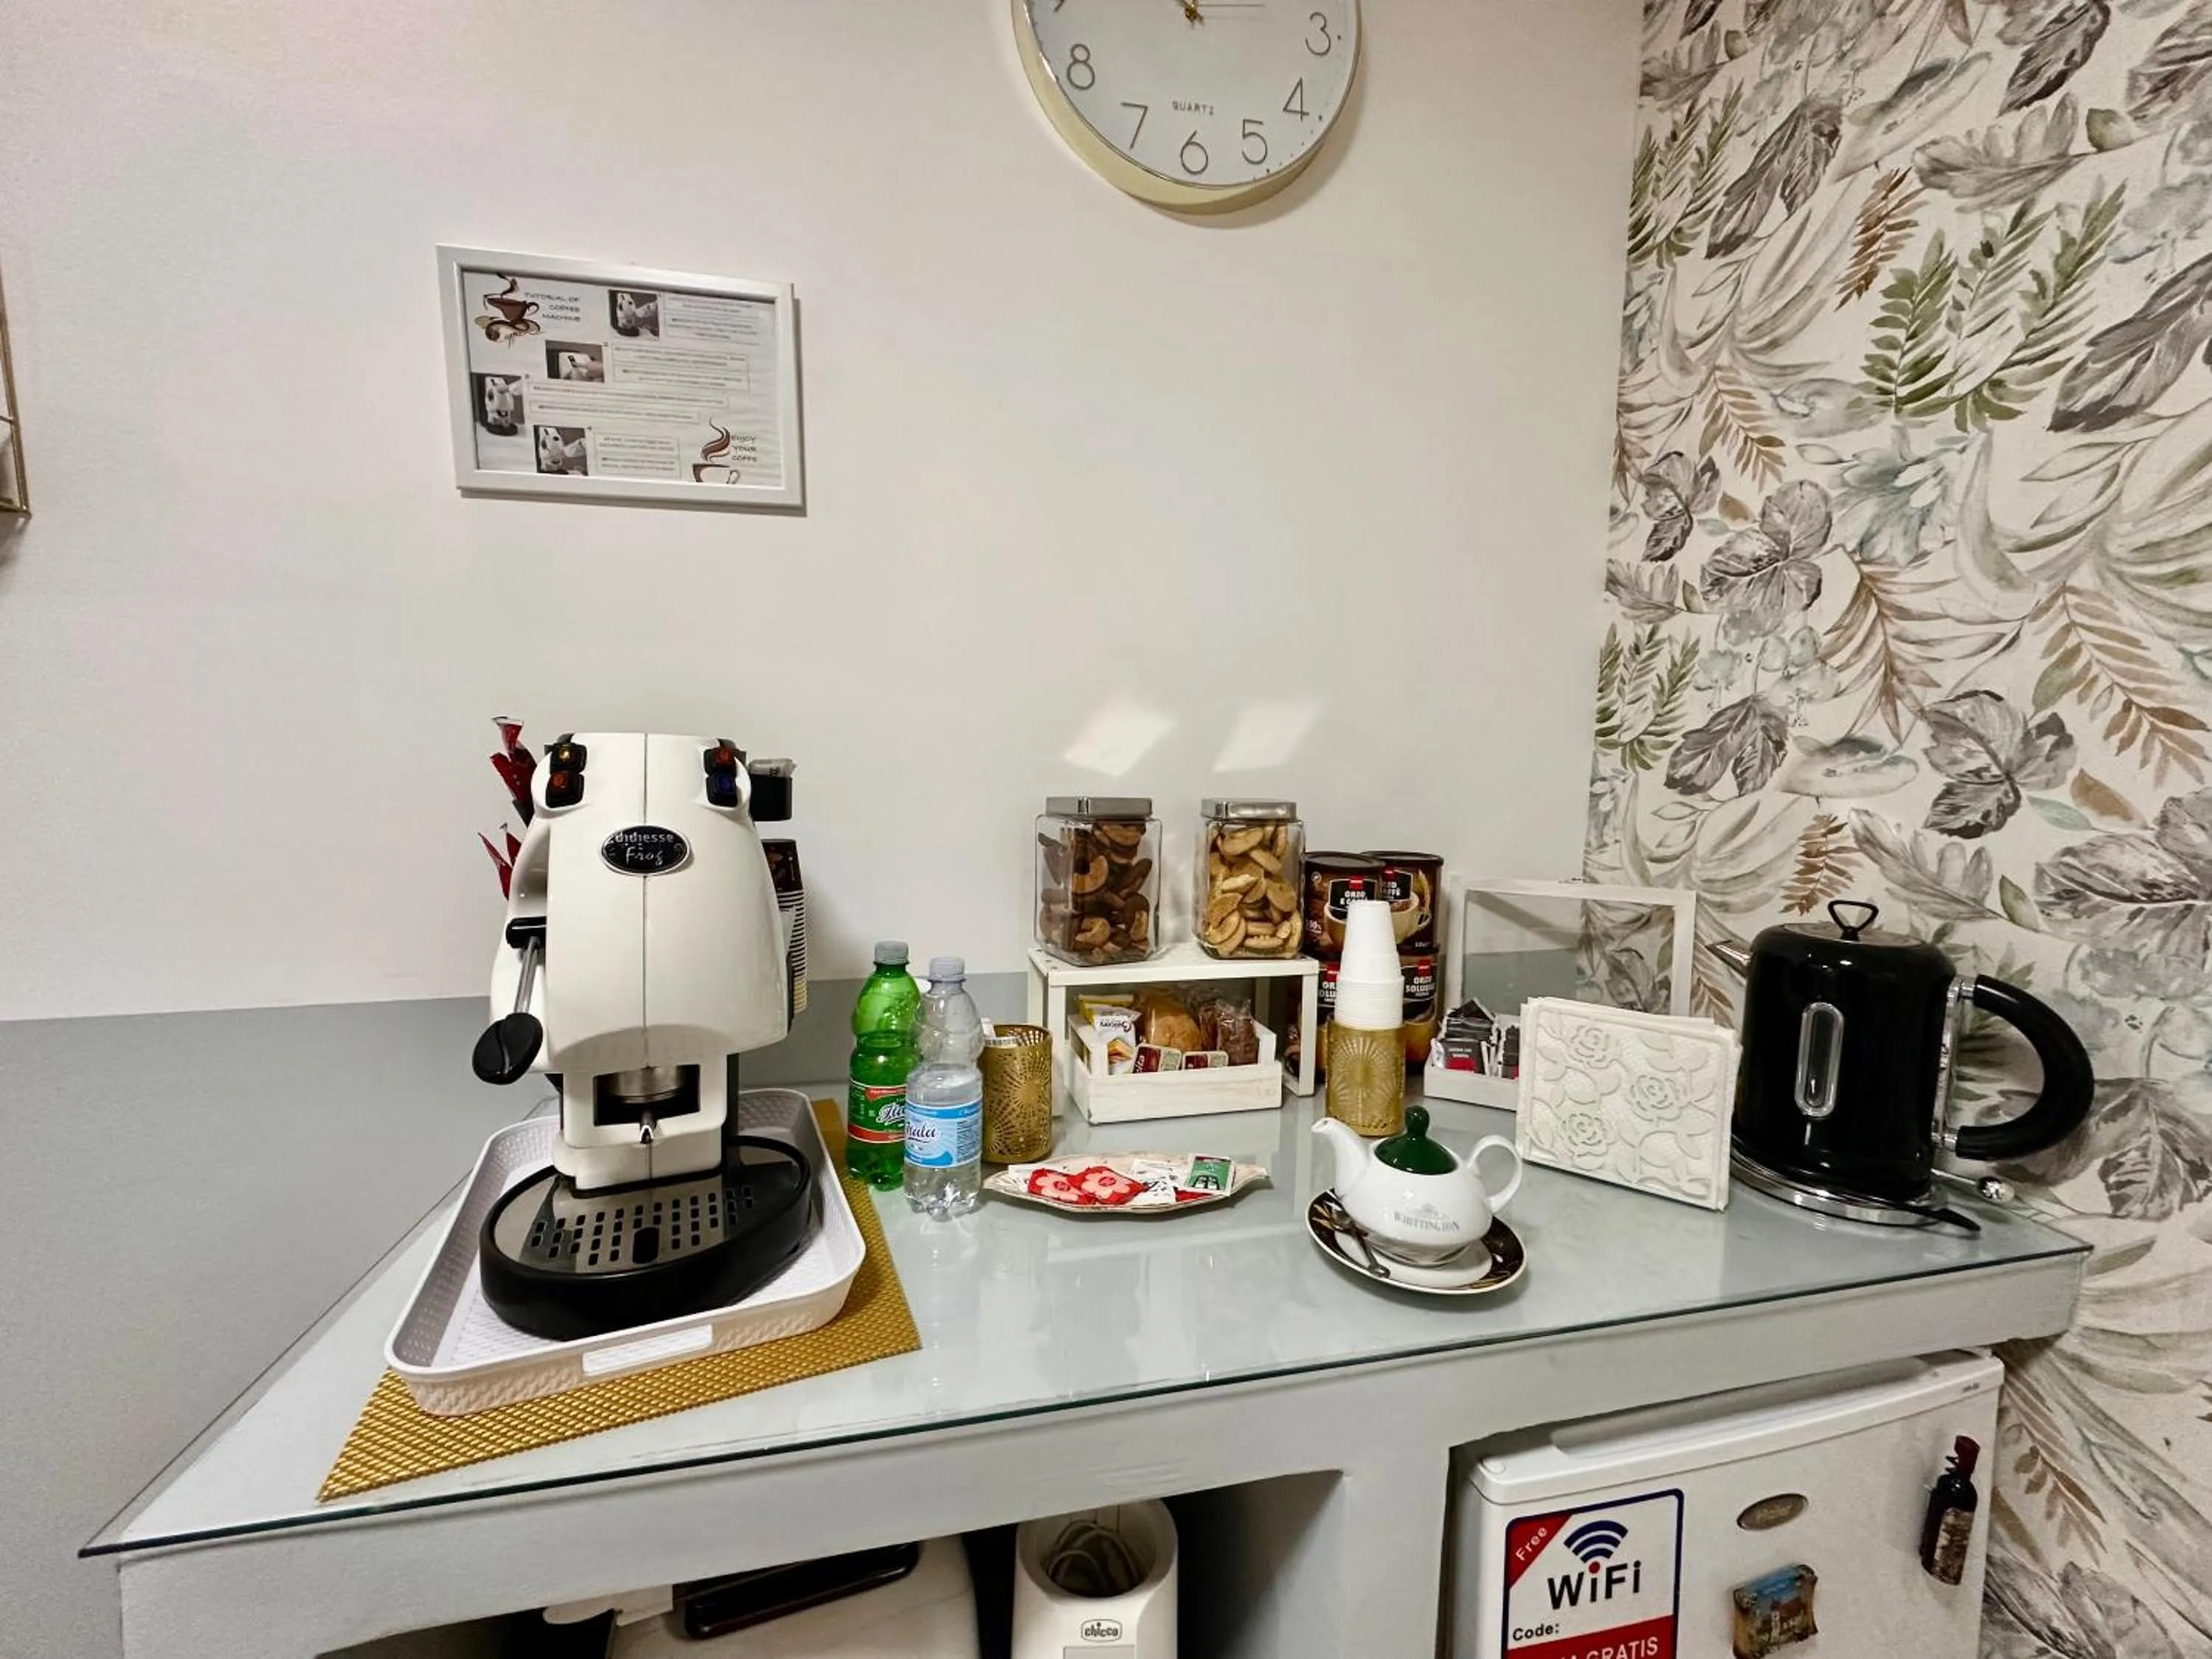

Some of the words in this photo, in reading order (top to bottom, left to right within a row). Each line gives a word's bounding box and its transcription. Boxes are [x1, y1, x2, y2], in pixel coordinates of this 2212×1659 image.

[1305, 12, 1332, 57] 3
[1066, 44, 1096, 91] 8
[1172, 100, 1215, 117] QUARTZ
[1282, 77, 1310, 122] 4
[1121, 102, 1148, 150] 7
[1242, 119, 1267, 165] 5
[1180, 130, 1208, 175] 6
[1515, 1526, 1548, 1562] Free
[1547, 1560, 1642, 1610] WiFi
[1084, 1622, 1119, 1638] chicco
[1512, 1623, 1560, 1641] Code:
